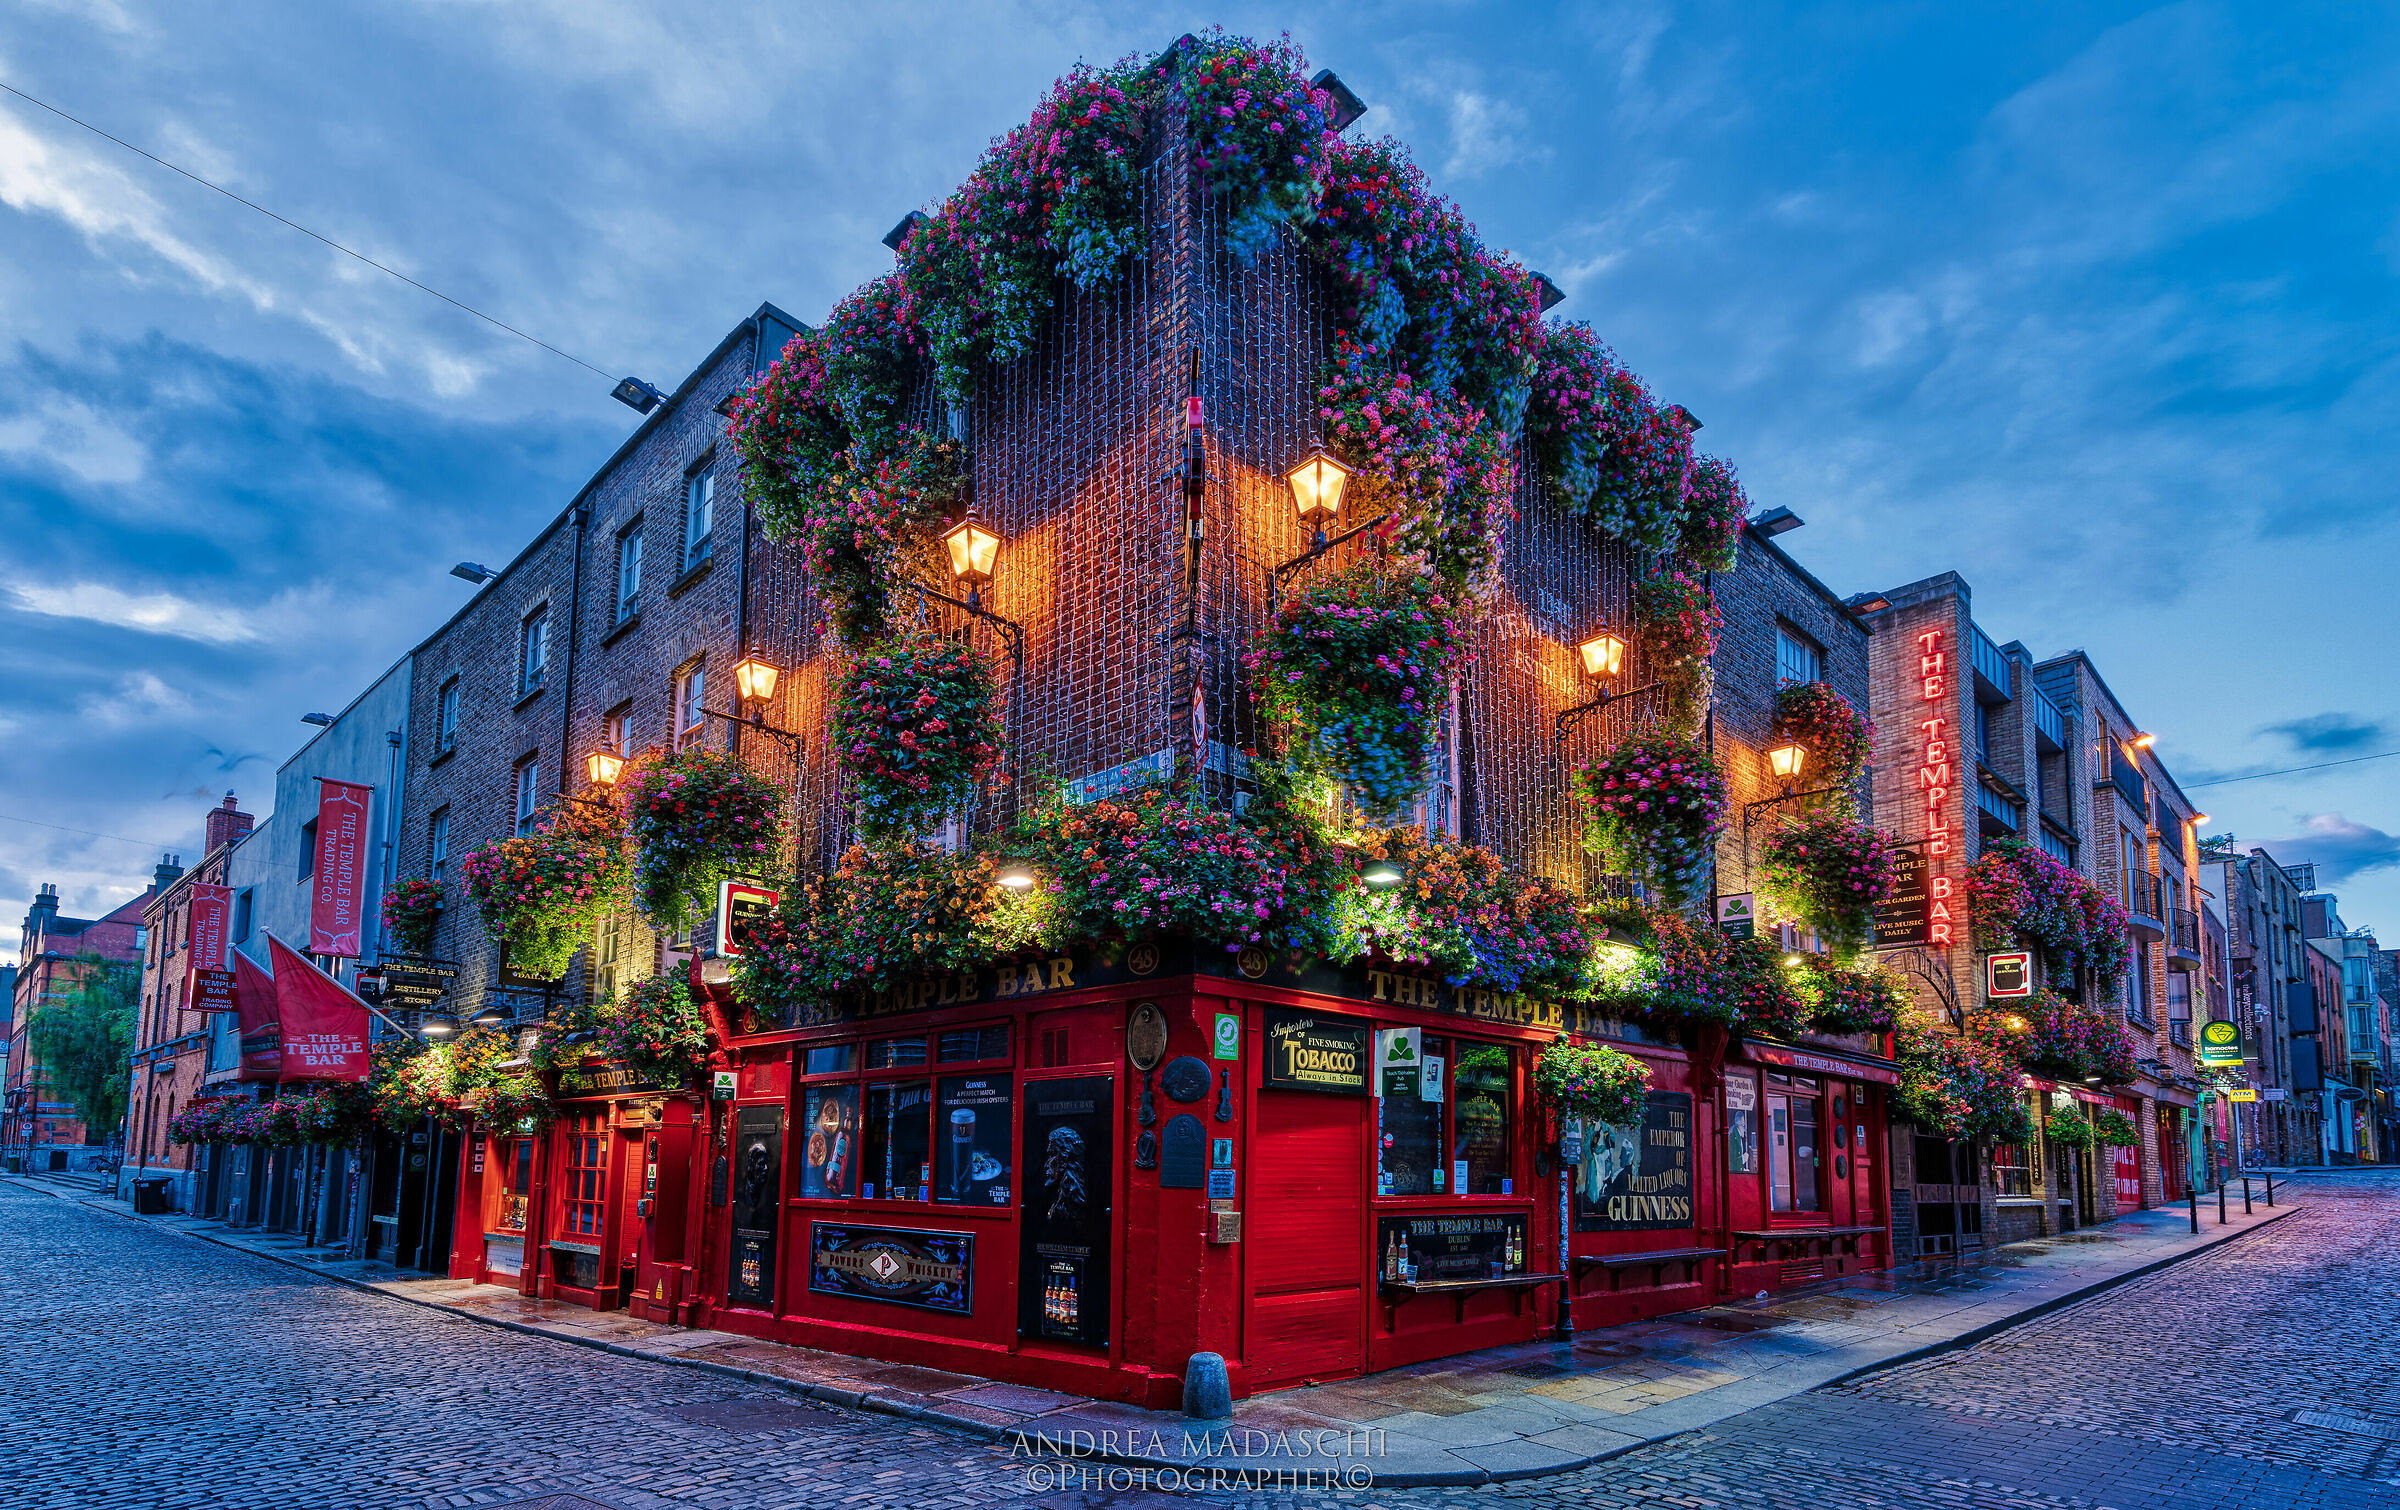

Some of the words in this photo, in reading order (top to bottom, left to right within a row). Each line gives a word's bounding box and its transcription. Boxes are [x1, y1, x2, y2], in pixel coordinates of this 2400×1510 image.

[1918, 629, 1947, 700] THE
[1920, 716, 1953, 857] TEMPLE
[341, 812, 357, 839] THE
[321, 829, 337, 884] TRADING
[336, 842, 355, 897] TEMPLE
[1895, 873, 1914, 882] AR
[320, 886, 333, 904] CO.
[1892, 894, 1926, 904] GARDEN
[207, 907, 221, 926] THE
[335, 899, 352, 926] BAR
[1929, 875, 1956, 945] BAR
[1873, 922, 1894, 931] LIVE
[1895, 919, 1924, 928] MUSIC
[1884, 928, 1912, 937] DAILY
[194, 920, 206, 960] TRADING
[204, 928, 220, 968] TEMPLE
[1132, 951, 1153, 970] 48
[1242, 951, 1262, 971] 48
[209, 972, 230, 982] THE
[384, 963, 402, 972] THE
[403, 965, 437, 975] TEMPLE
[438, 968, 455, 978] BAR
[199, 979, 238, 990] TEMPLE
[206, 987, 228, 996] BAR
[394, 984, 443, 995] DISTILLERY
[856, 972, 980, 1017] TEMPLE
[996, 957, 1075, 997] BAR
[198, 1002, 233, 1010] COMPANY
[201, 997, 232, 1005] TRADING
[404, 996, 432, 1005] STORE
[1368, 970, 1440, 1009] THE
[1450, 985, 1565, 1029] TEMPLE
[1576, 1009, 1624, 1039] BAR
[307, 1034, 341, 1043] THE
[1270, 1019, 1314, 1040] Importers
[283, 1042, 363, 1055] TEMPLE
[1308, 1037, 1325, 1047] FINE
[1325, 1039, 1356, 1051] SMOKING
[305, 1054, 347, 1066] BAR
[1281, 1039, 1356, 1076] TOBACCO
[1793, 1054, 1809, 1067] THE
[1809, 1057, 1835, 1071] TEMPLE
[1835, 1061, 1848, 1074] BAR
[596, 1070, 636, 1088] TEMPLE
[965, 1081, 987, 1089] GUINNESS
[1297, 1070, 1326, 1081] Always
[1339, 1073, 1362, 1084] Stock
[1669, 1111, 1685, 1128] THE
[1650, 1129, 1685, 1148] EMPEROR
[1676, 1151, 1685, 1167] OF
[1627, 1174, 1658, 1193] MALTED
[1659, 1168, 1688, 1190] LIQUORS
[989, 1190, 1010, 1198] TEMPLE
[1608, 1195, 1690, 1221] GUINNESS
[1410, 1220, 1435, 1236] THE
[1437, 1218, 1481, 1235] TEMPLE
[1483, 1218, 1504, 1233] BAR
[1448, 1235, 1471, 1244] DUBLIN
[829, 1254, 864, 1269] POWERS
[880, 1255, 891, 1277] P
[906, 1261, 953, 1279] WHISKEY
